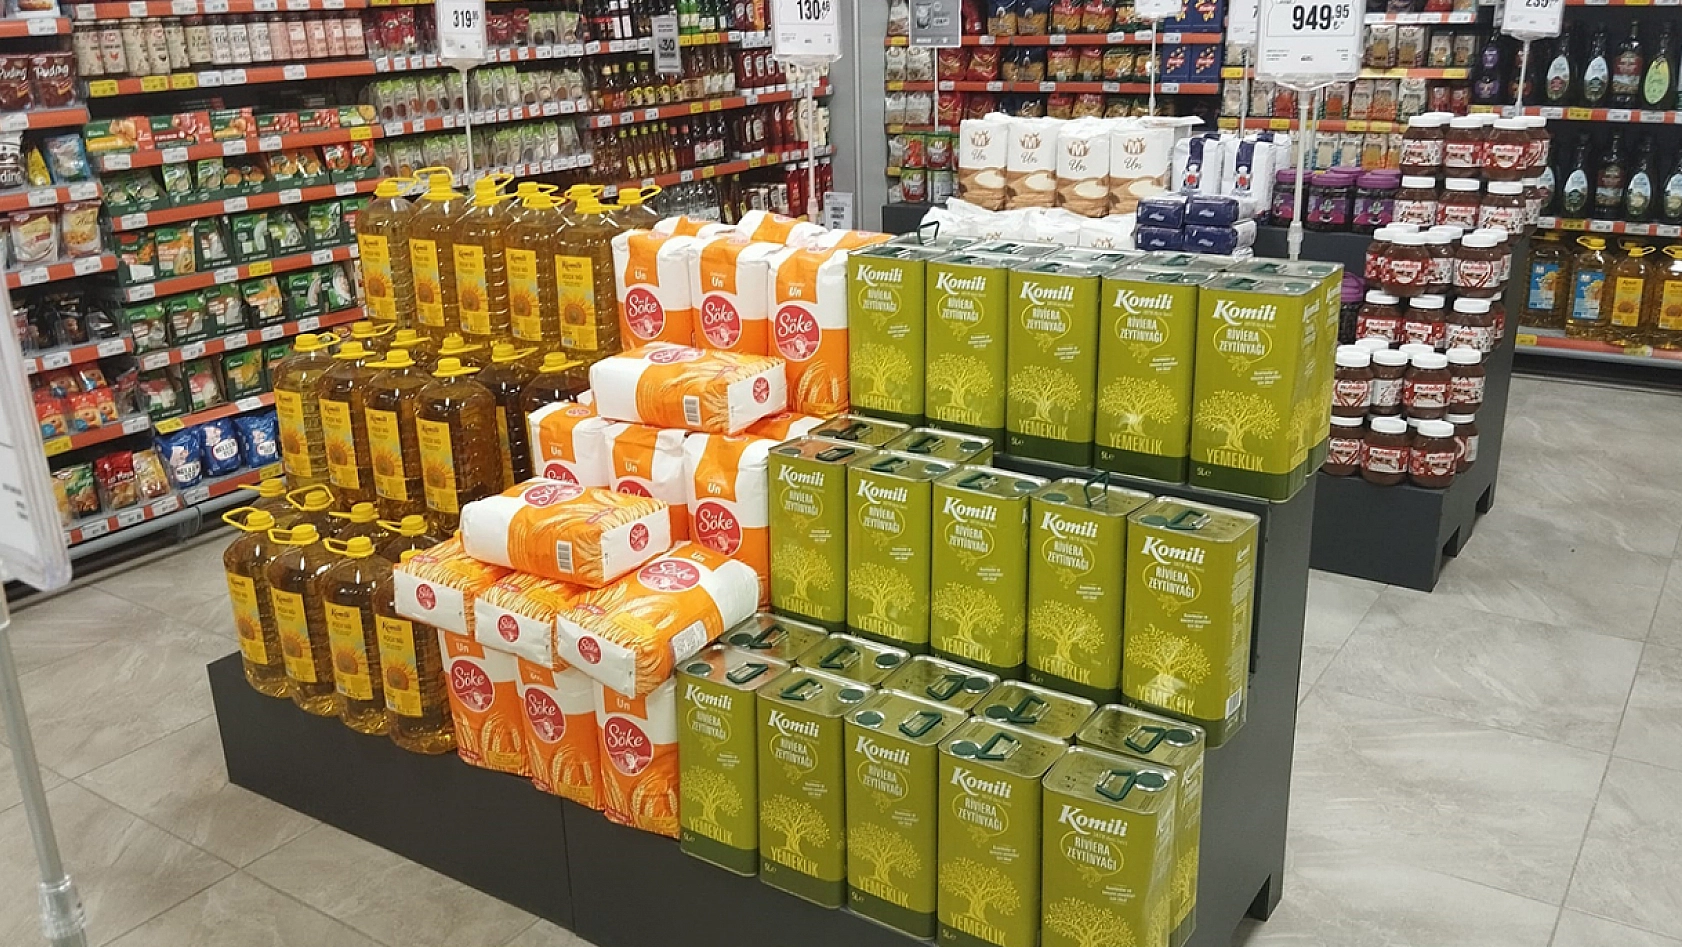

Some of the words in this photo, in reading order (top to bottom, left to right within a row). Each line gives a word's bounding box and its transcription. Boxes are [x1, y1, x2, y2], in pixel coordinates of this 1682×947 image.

[634, 269, 647, 280] Un
[711, 277, 724, 288] Un
[856, 264, 903, 287] Komili
[935, 271, 986, 294] Komili
[1020, 281, 1075, 305] Komili
[1113, 289, 1174, 314] Komili
[629, 296, 657, 317] Söke
[704, 305, 735, 325] Söke
[1212, 299, 1278, 326] Komili
[777, 313, 813, 337] Söke
[551, 445, 562, 457] Un
[625, 461, 638, 473] Un
[778, 463, 825, 488] Komili
[707, 481, 721, 494] Un
[857, 478, 909, 504] Komili
[698, 508, 734, 531] Söke
[942, 496, 998, 522] Komili
[1040, 511, 1099, 539] Komili
[1141, 535, 1206, 565] Komili
[456, 641, 469, 653] Un
[454, 668, 486, 689] Söke
[528, 696, 556, 716] Söke
[617, 698, 631, 710] Un
[684, 683, 733, 710] Komili
[767, 709, 821, 738] Komili
[608, 726, 643, 748] Söke
[854, 735, 911, 766] Komili
[950, 766, 1012, 799] Komili
[1058, 804, 1128, 837] Komili
